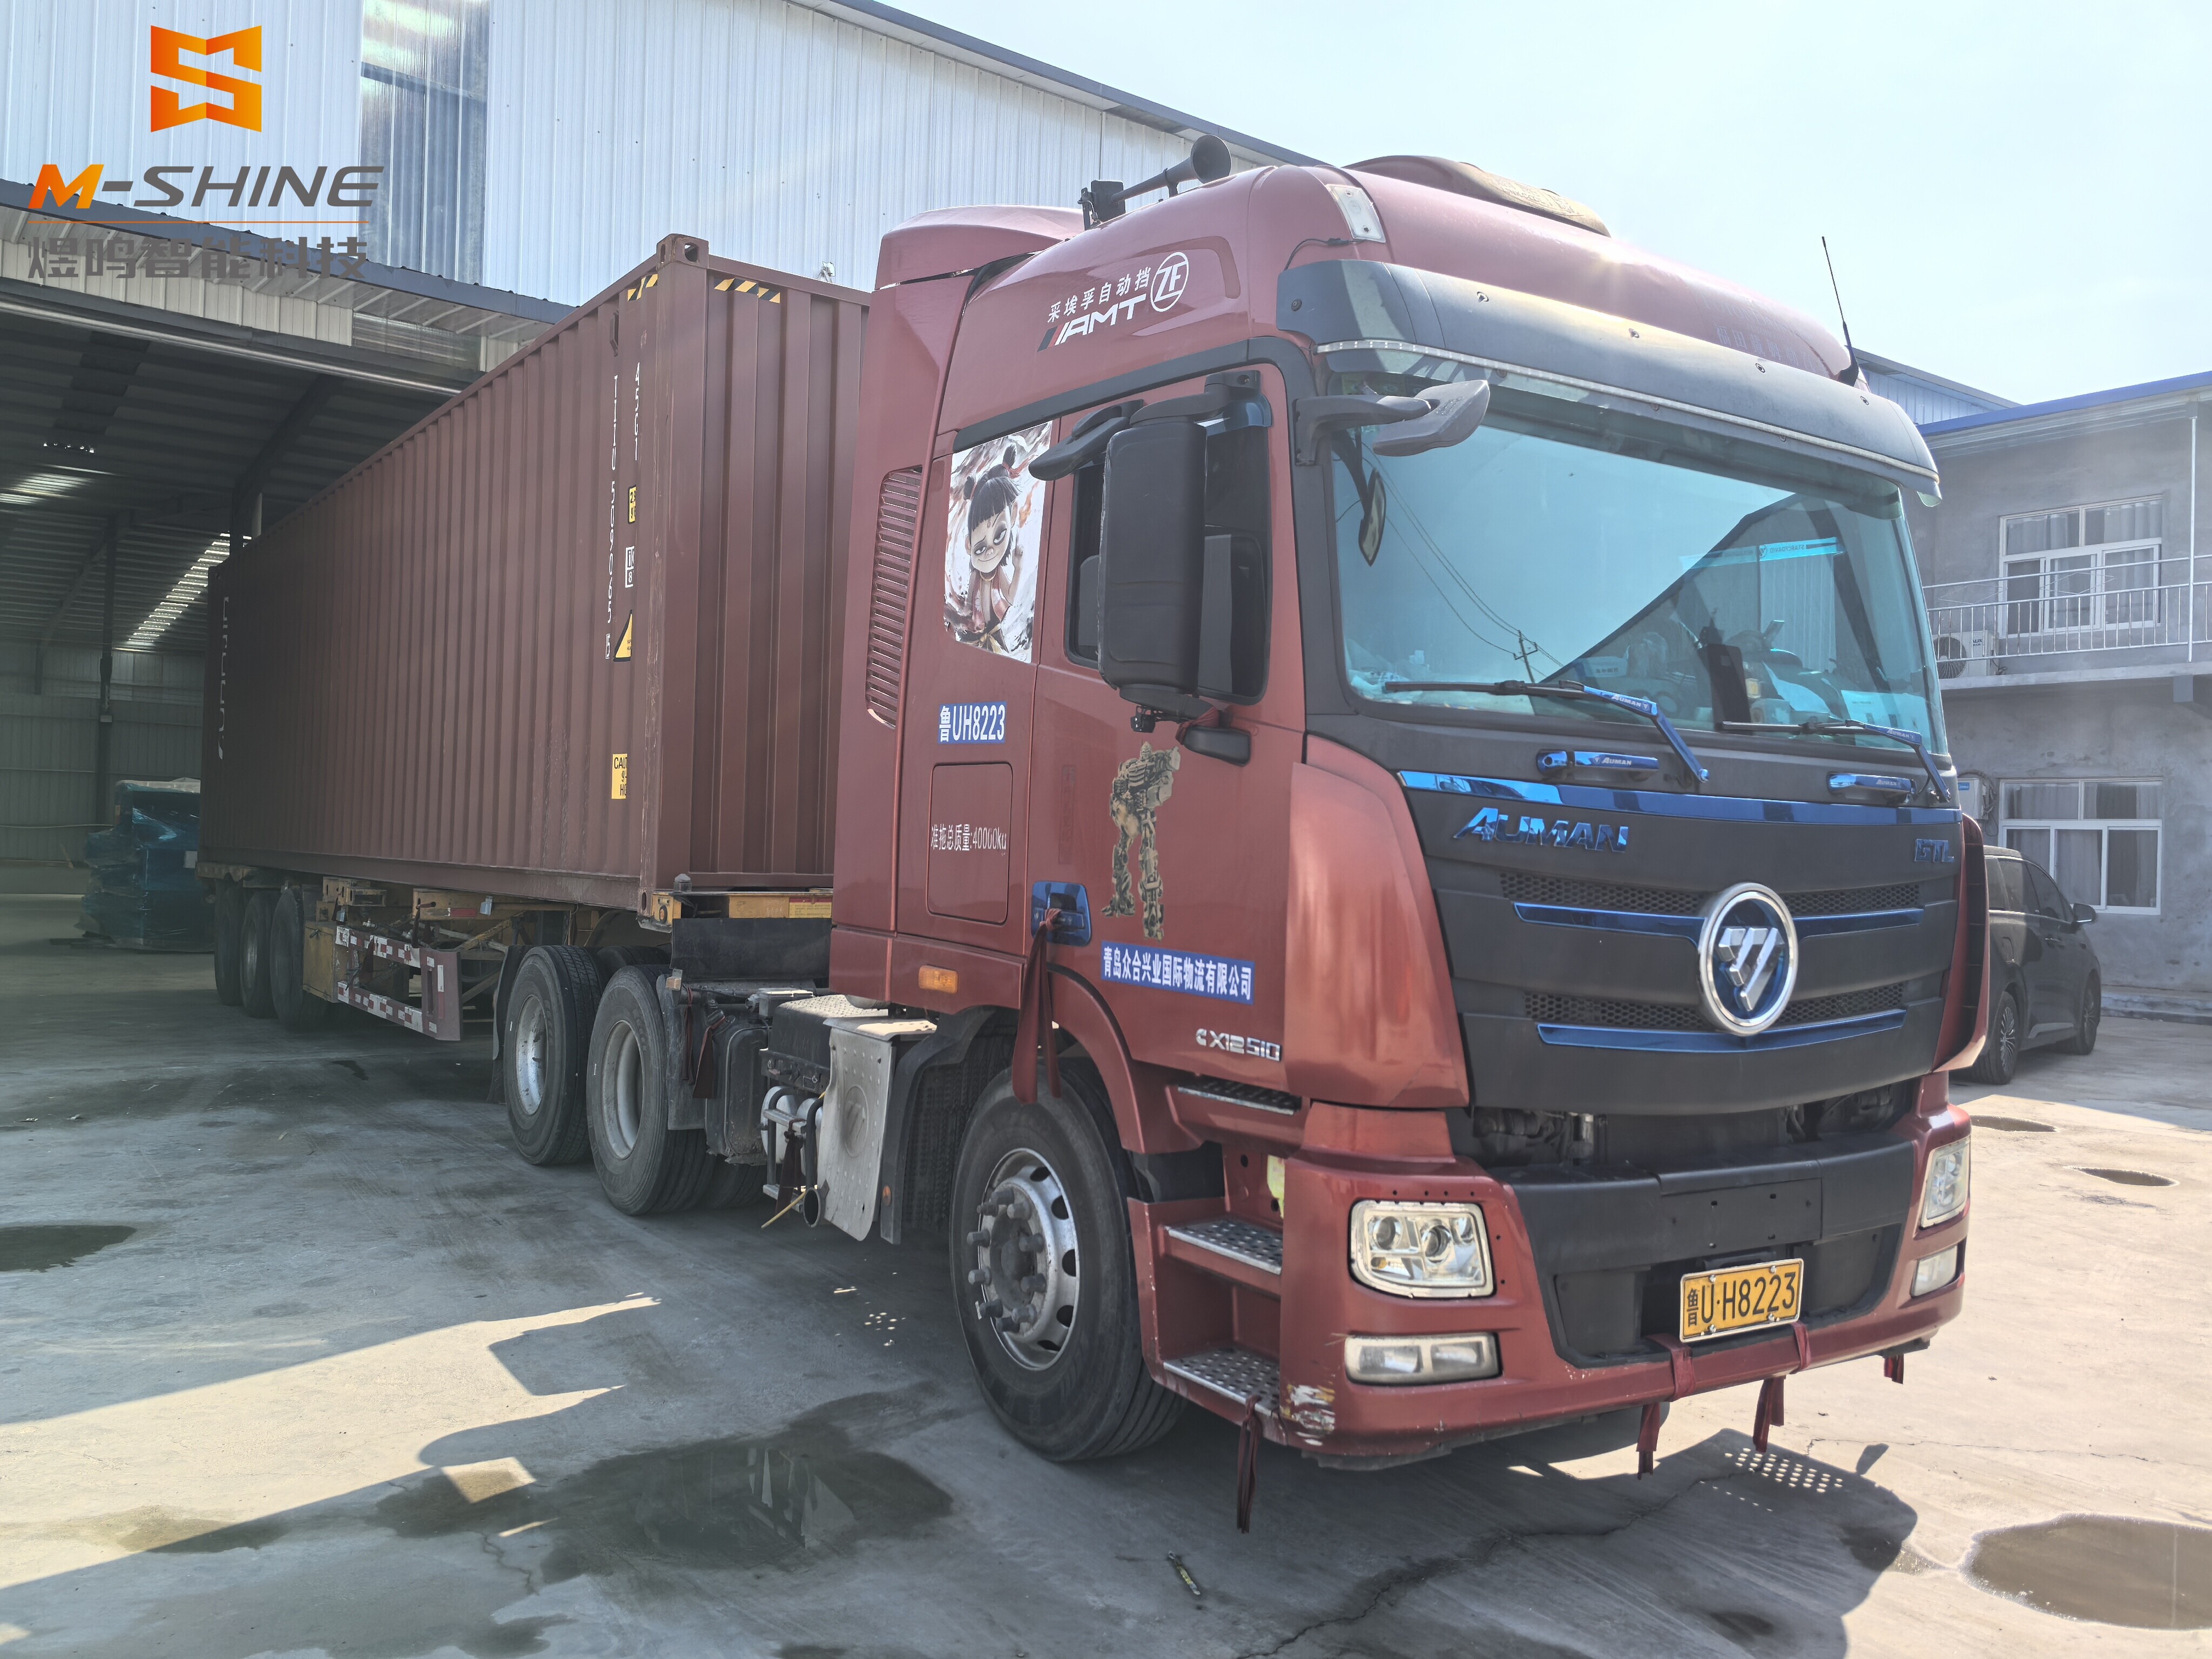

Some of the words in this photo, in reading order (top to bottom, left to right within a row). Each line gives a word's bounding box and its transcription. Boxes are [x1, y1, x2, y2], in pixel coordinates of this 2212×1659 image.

[1047, 266, 1151, 323] 采埃孚自动挡
[1154, 259, 1188, 305] ZF
[1611, 693, 1642, 707] AUMAN
[939, 704, 1005, 742] 鲁UH8223
[1601, 757, 1632, 766] AUMAN
[1453, 806, 1629, 853] AUMAN
[1914, 838, 1954, 863] GTL
[1103, 946, 1252, 1001] 青岛众合兴业国际物流有限公司
